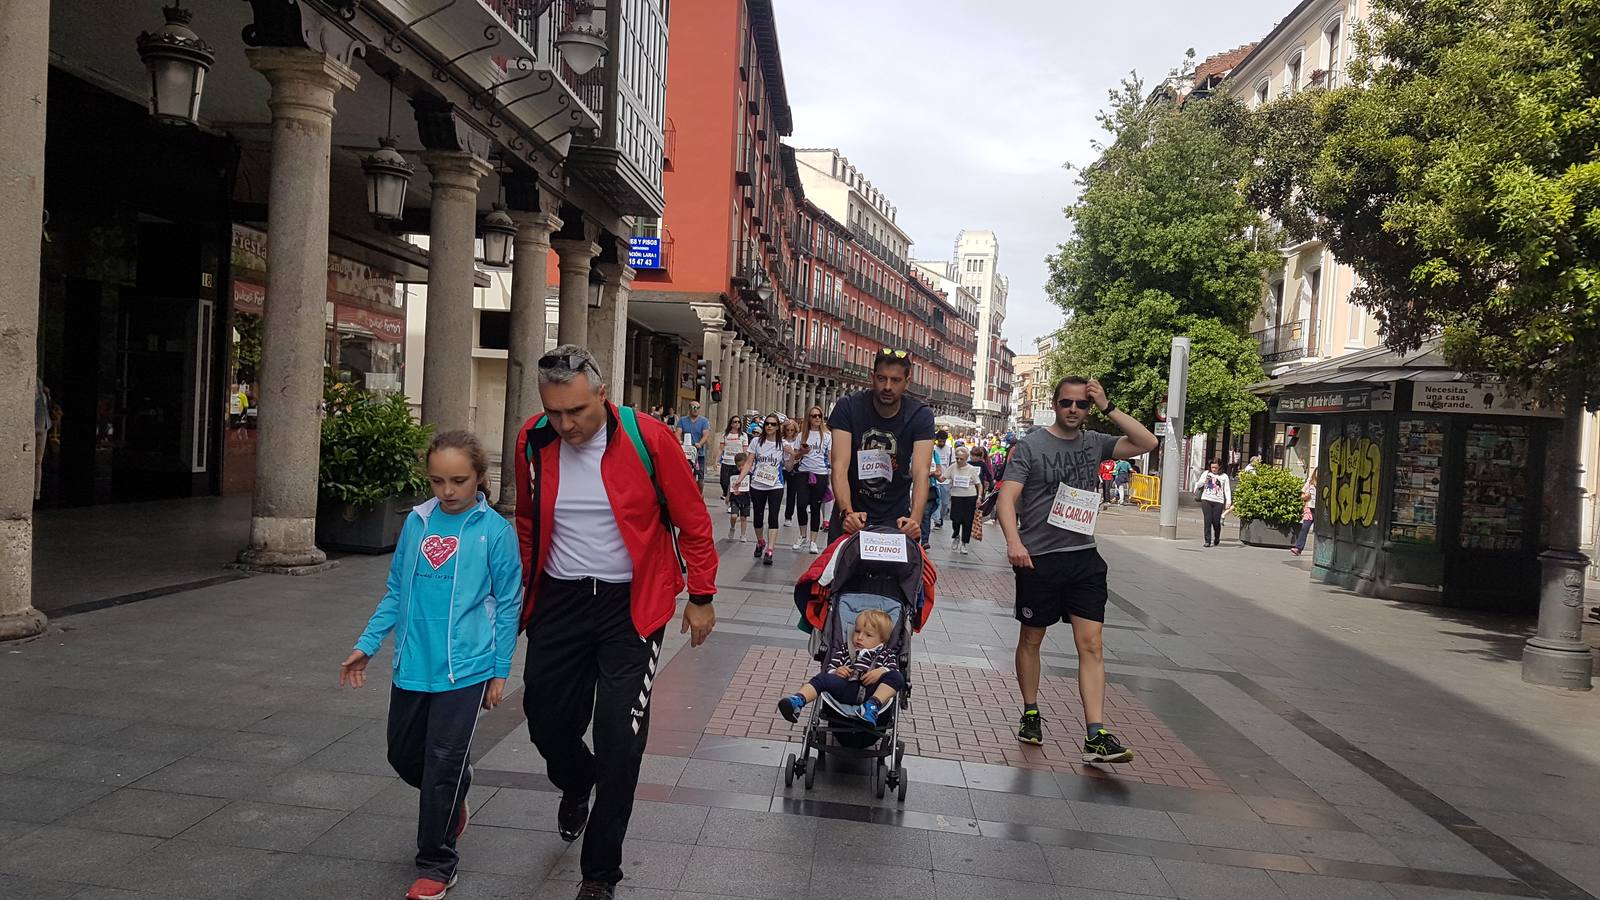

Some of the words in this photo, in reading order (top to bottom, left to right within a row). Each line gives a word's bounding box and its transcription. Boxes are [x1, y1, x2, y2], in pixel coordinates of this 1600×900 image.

[644, 258, 652, 266] 43
[1425, 386, 1468, 395] Necesitas
[861, 462, 874, 471] LOS
[874, 462, 891, 472] DINOS
[1052, 501, 1065, 517] LEAL
[1065, 505, 1095, 524] CARLON
[864, 544, 878, 552] LOS
[878, 546, 902, 554] DINOS
